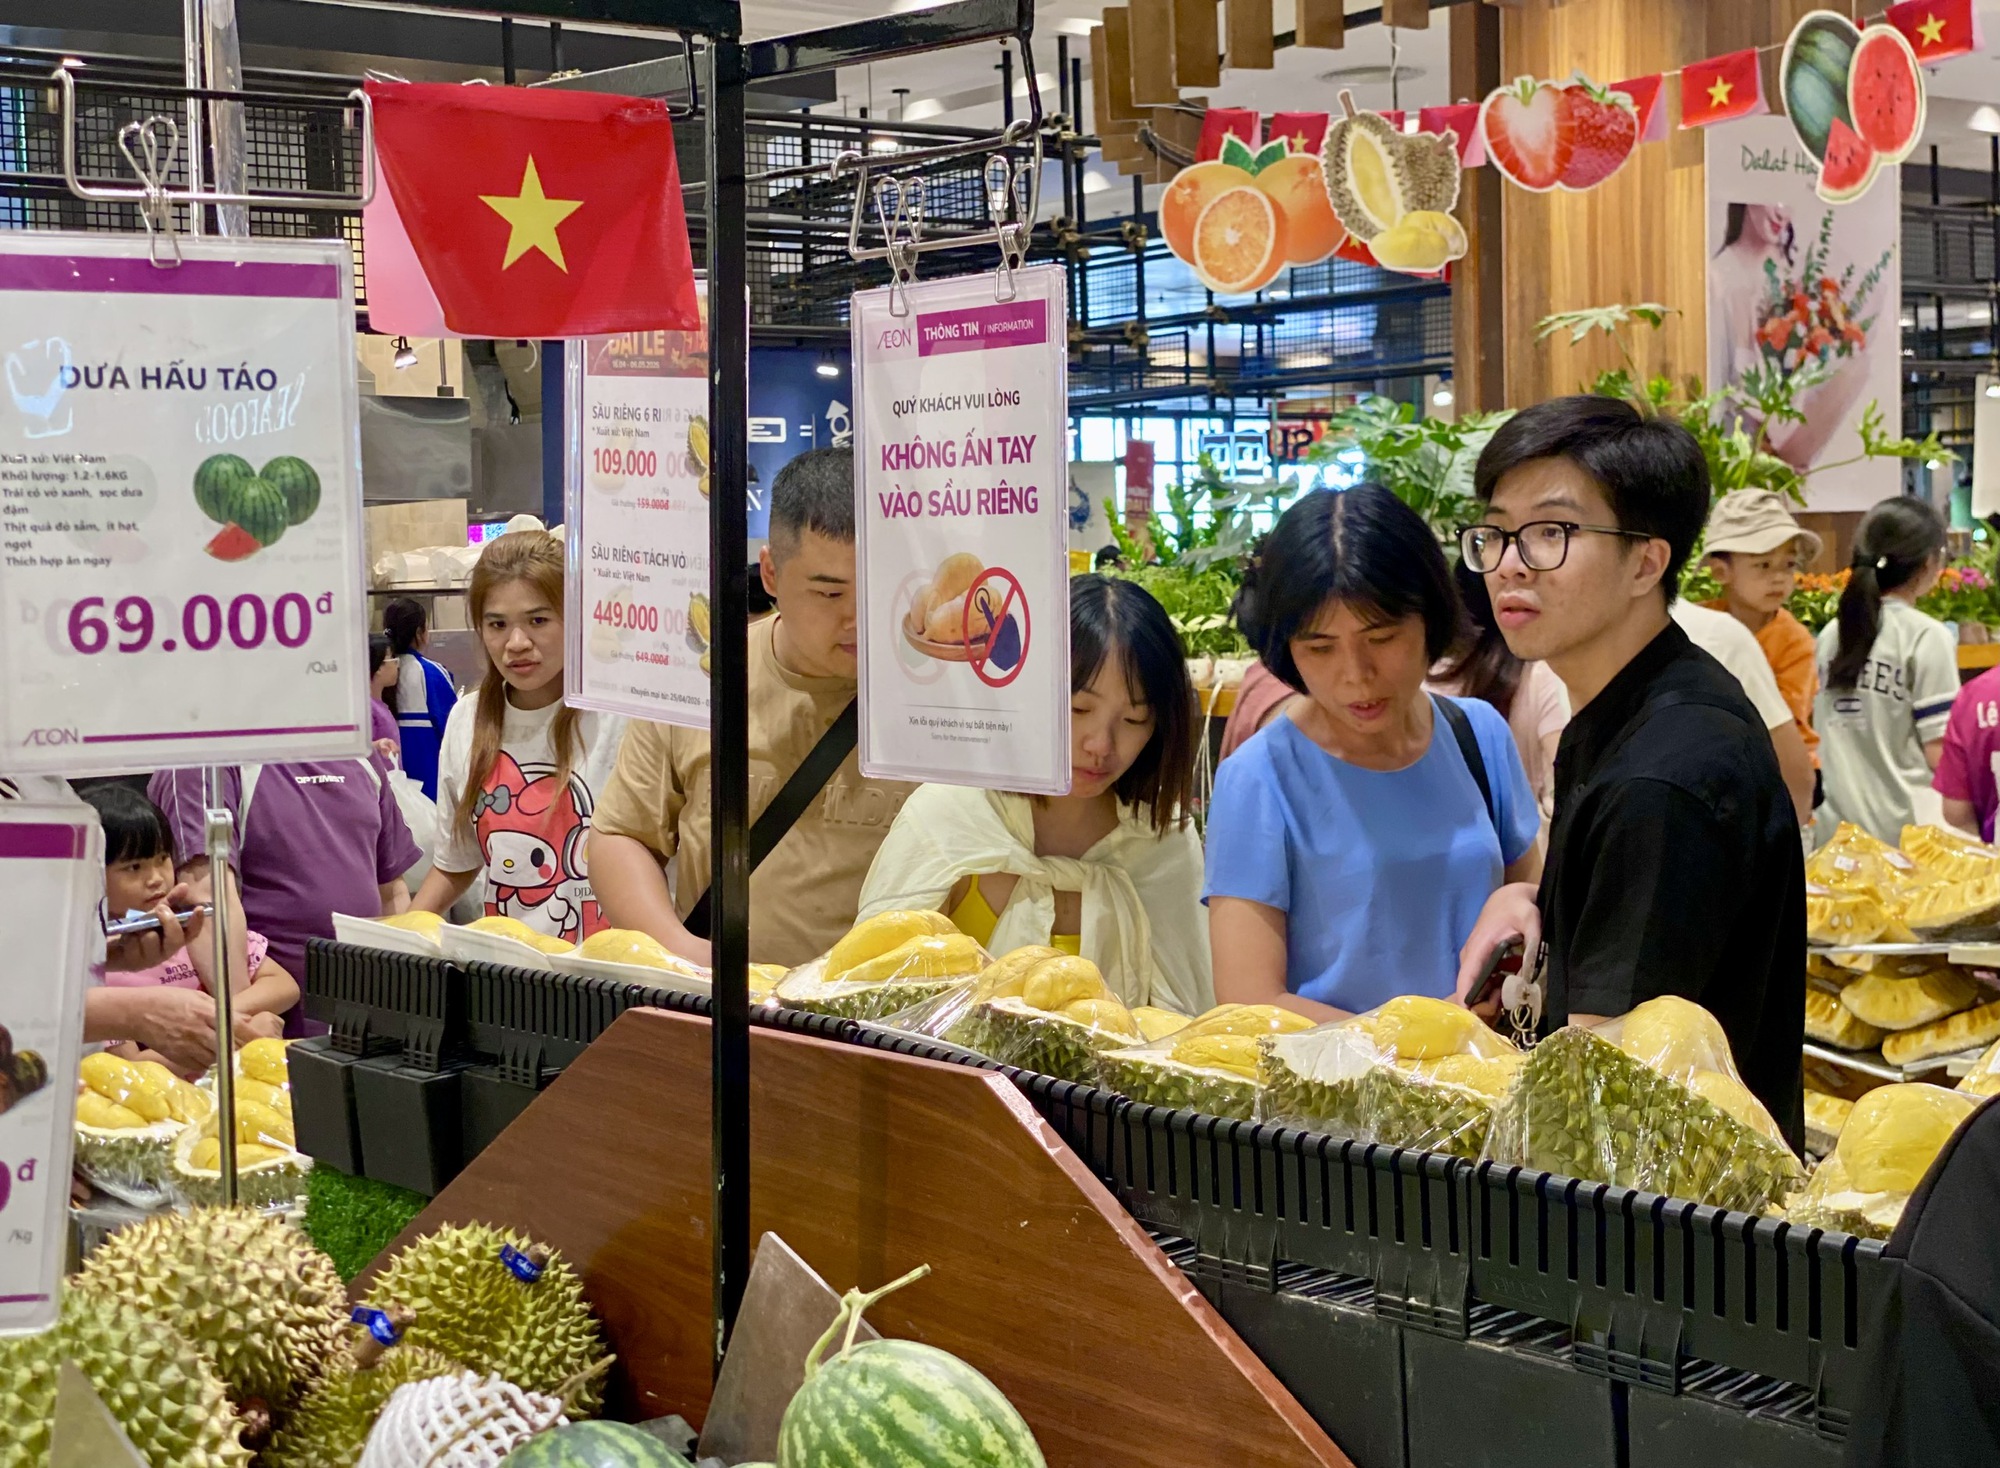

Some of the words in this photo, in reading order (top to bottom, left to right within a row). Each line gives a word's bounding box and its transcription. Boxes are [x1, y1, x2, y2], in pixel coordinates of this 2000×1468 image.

[1741, 144, 1787, 172] Dalat
[924, 322, 960, 340] THÔNG
[962, 321, 979, 336] TIN
[59, 361, 130, 390] DƯA
[141, 359, 207, 391] HẤU
[217, 361, 278, 391] TÁO
[592, 401, 611, 419] SẦU
[613, 403, 641, 421] RIÊNG
[644, 407, 650, 421] 6
[653, 408, 661, 422] RI
[893, 395, 916, 418] QUÝ
[919, 393, 961, 413] KHÁCH
[964, 393, 985, 410] VUI
[988, 388, 1020, 407] LÒNG
[594, 447, 657, 478] 109.000
[882, 435, 957, 471] KHÔNG
[962, 428, 992, 466] ẤN
[998, 435, 1037, 465] TAY
[879, 484, 922, 519] VÀO
[928, 479, 971, 517] SẦU
[977, 480, 1038, 516] RIÊNG
[591, 542, 610, 560] SẦU
[612, 545, 641, 564] RIÊNG
[643, 548, 669, 567] TÁCH
[672, 551, 686, 569] VỎ
[593, 600, 658, 632] 449.000
